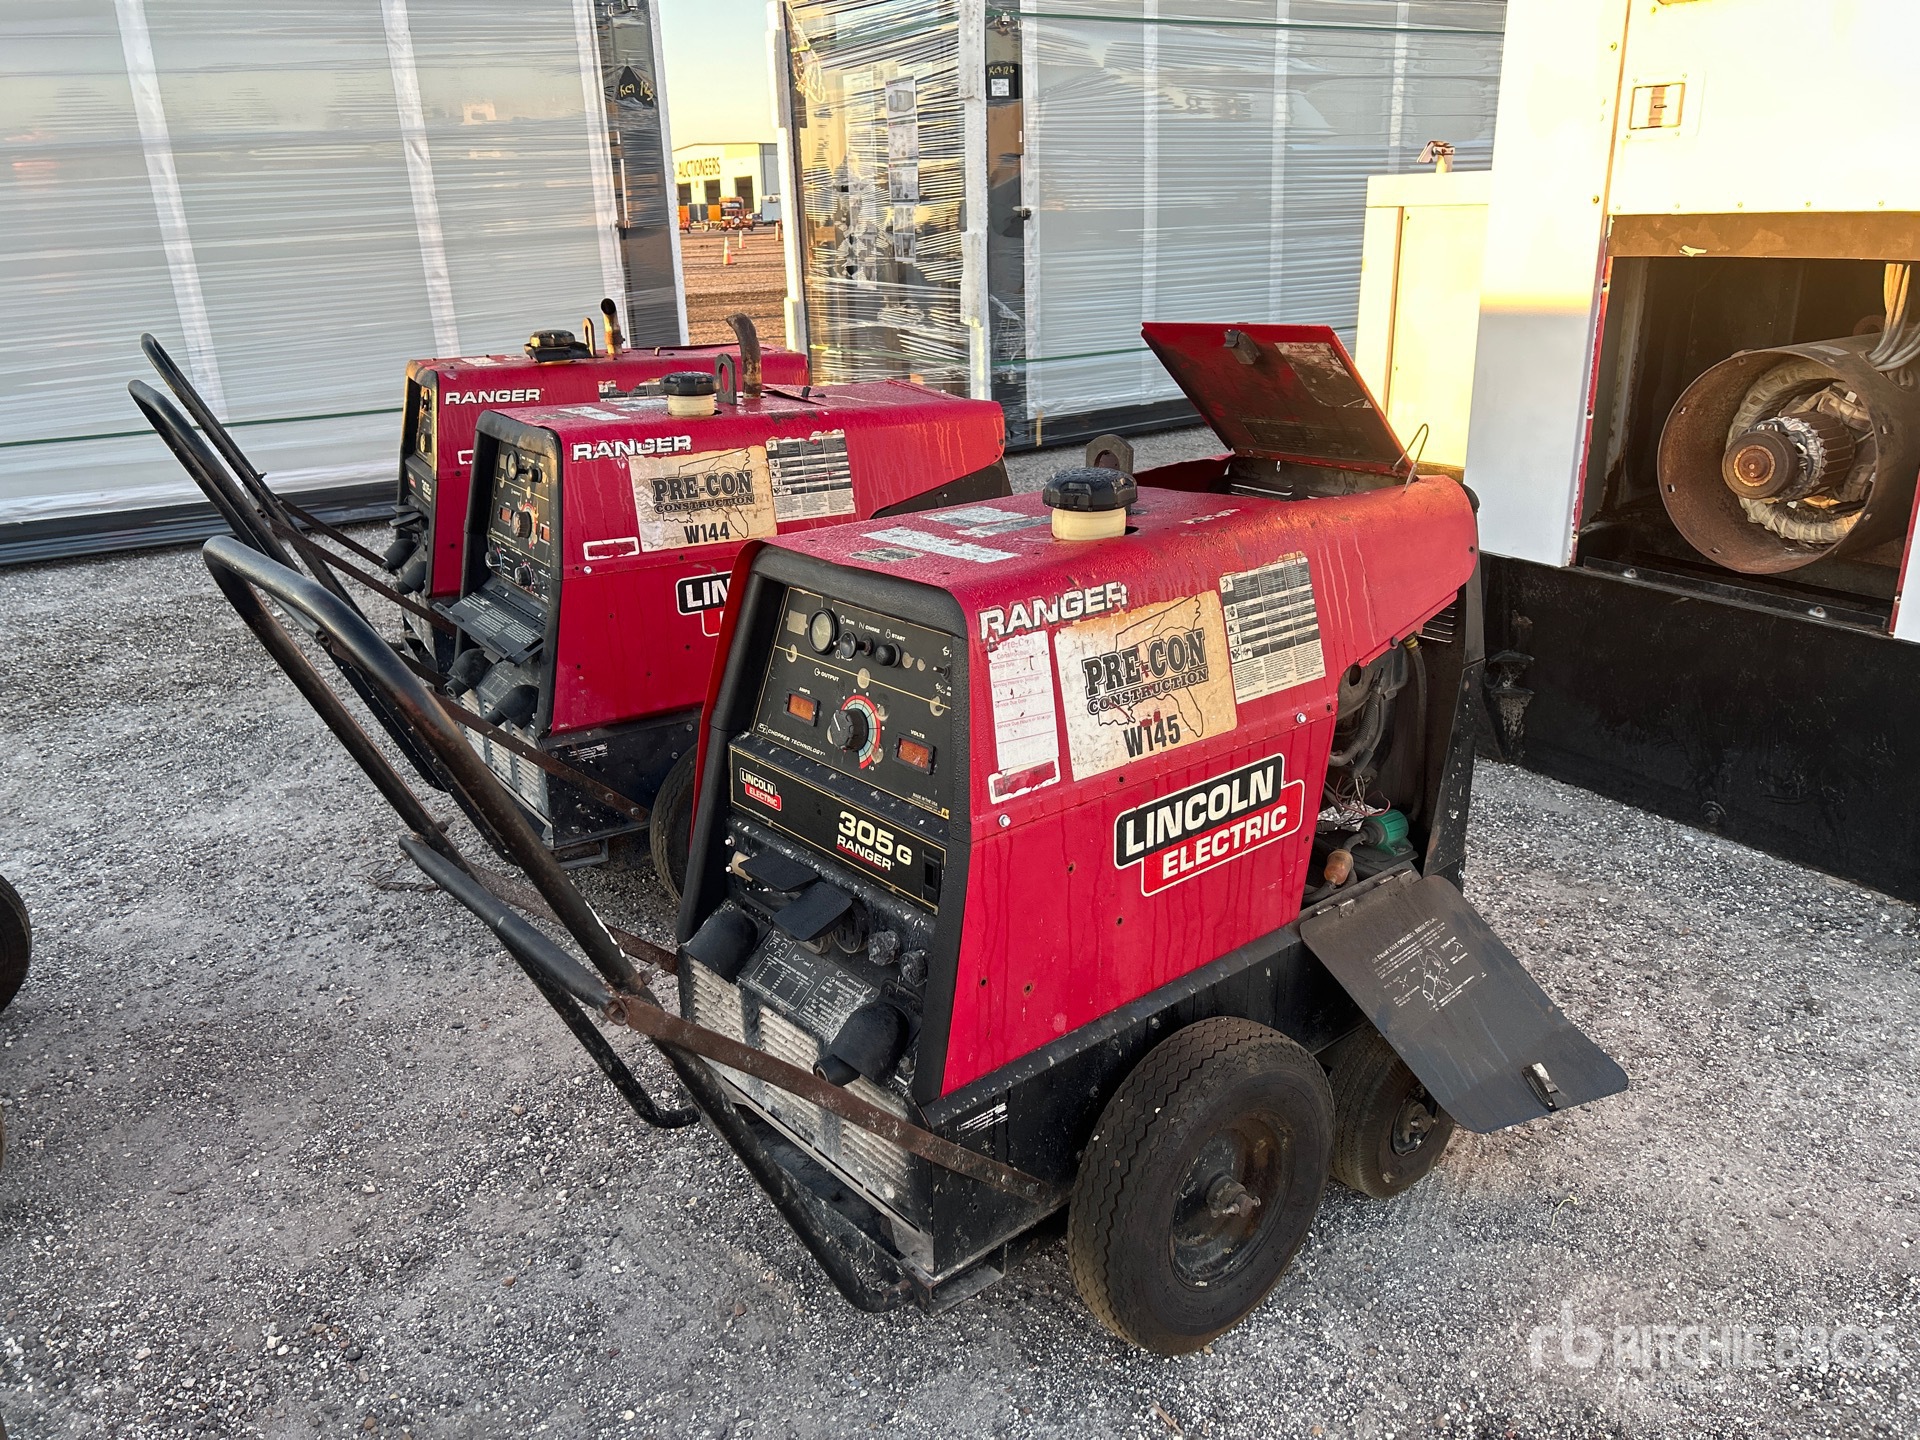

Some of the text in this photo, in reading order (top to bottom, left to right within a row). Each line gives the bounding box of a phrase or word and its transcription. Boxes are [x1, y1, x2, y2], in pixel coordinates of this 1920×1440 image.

[445, 388, 541, 405] RANGER
[572, 435, 692, 462] RANGER
[651, 469, 753, 502] PRE-CON
[655, 495, 755, 515] CONSTRUCTION
[684, 522, 730, 545] W144
[979, 581, 1128, 640] RANGER
[1081, 627, 1208, 699] PRE-CON
[1087, 667, 1210, 715] CONSTRUCTION
[1122, 714, 1181, 758] W145
[741, 770, 775, 796] LINCOLN
[749, 787, 778, 807] ELECTRIC
[1126, 766, 1275, 857] LINCOLN
[837, 835, 893, 872] RANGER
[1162, 805, 1288, 880] ELECTRIC
